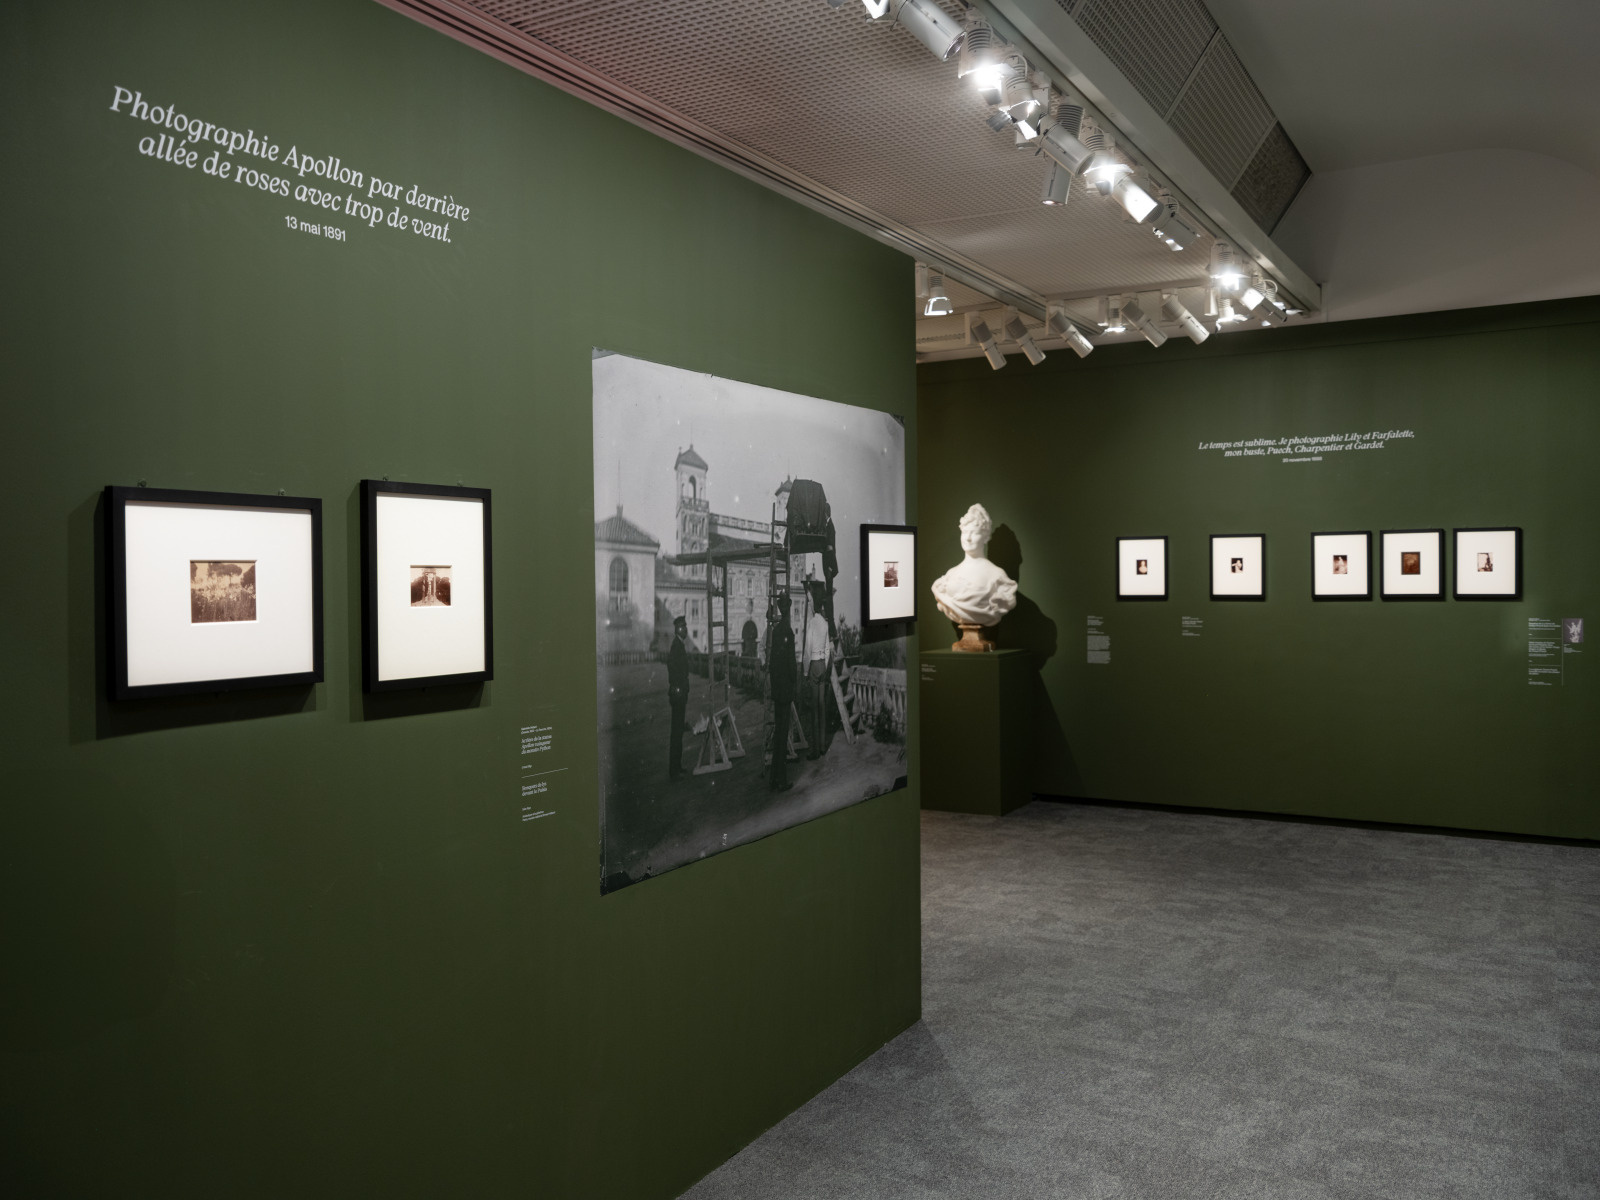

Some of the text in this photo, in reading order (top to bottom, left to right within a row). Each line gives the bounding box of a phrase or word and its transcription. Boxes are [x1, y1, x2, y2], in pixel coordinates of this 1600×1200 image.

[109, 85, 470, 222] Photographie Apollon par derrière
[138, 133, 453, 244] allée de roses avec trop de vent.
[284, 215, 347, 242] 13 mai 1891
[1198, 442, 1208, 450] Le
[1209, 442, 1232, 450] temps
[1244, 438, 1277, 447] sublime.
[1278, 437, 1287, 445] Je
[1288, 434, 1344, 447] photographie
[1344, 433, 1362, 442] Lily
[1294, 443, 1344, 453] Charpentier
